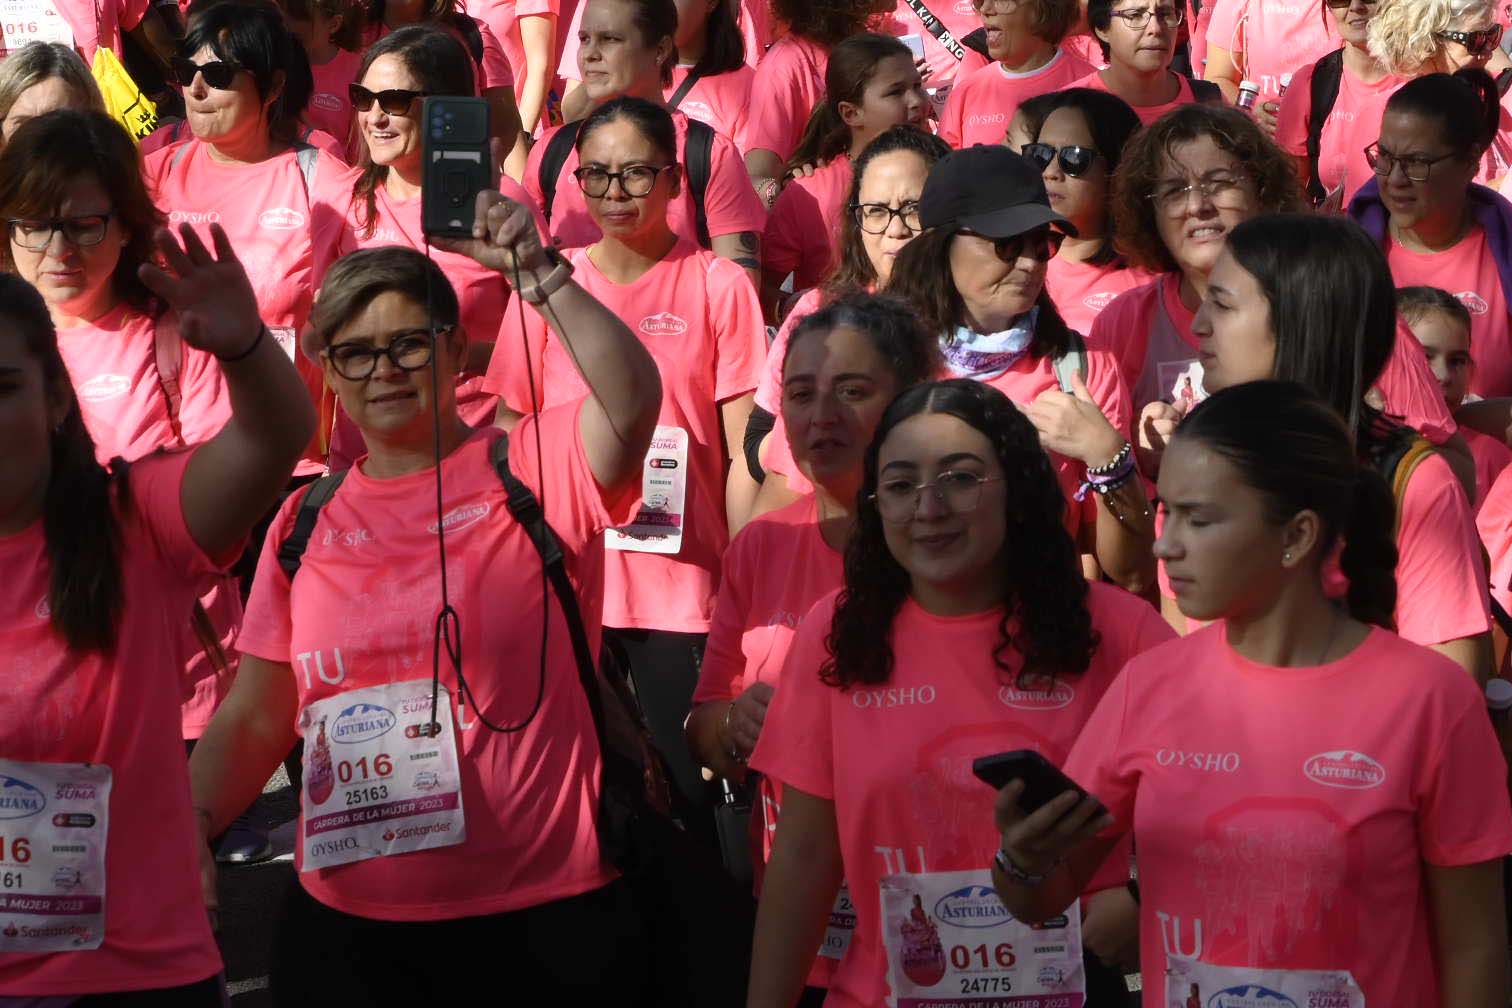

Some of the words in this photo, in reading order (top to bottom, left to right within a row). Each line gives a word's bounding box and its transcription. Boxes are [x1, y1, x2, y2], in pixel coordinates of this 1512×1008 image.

[169, 211, 220, 224] OYSHO
[650, 441, 677, 450] SUMA
[295, 647, 345, 689] TU
[852, 684, 937, 709] OYSHO
[336, 719, 390, 737] ASTURIANA
[338, 753, 393, 783] 016
[1156, 748, 1241, 773] OYSHO
[1311, 760, 1378, 781] ASTURIANA
[55, 790, 96, 801] SUMA
[346, 785, 389, 805] 25163
[313, 814, 350, 831] CARRERA
[353, 811, 366, 822] DE
[367, 808, 379, 819] LA
[381, 804, 416, 817] MUJER
[419, 800, 444, 811] 2023
[396, 822, 451, 839] Santander
[10, 898, 50, 911] MUJER
[1156, 911, 1202, 960] TU
[951, 943, 1016, 970] 016
[960, 977, 1012, 995] 24775
[1044, 998, 1069, 1008] 2023
[1308, 998, 1350, 1008] SUMA
